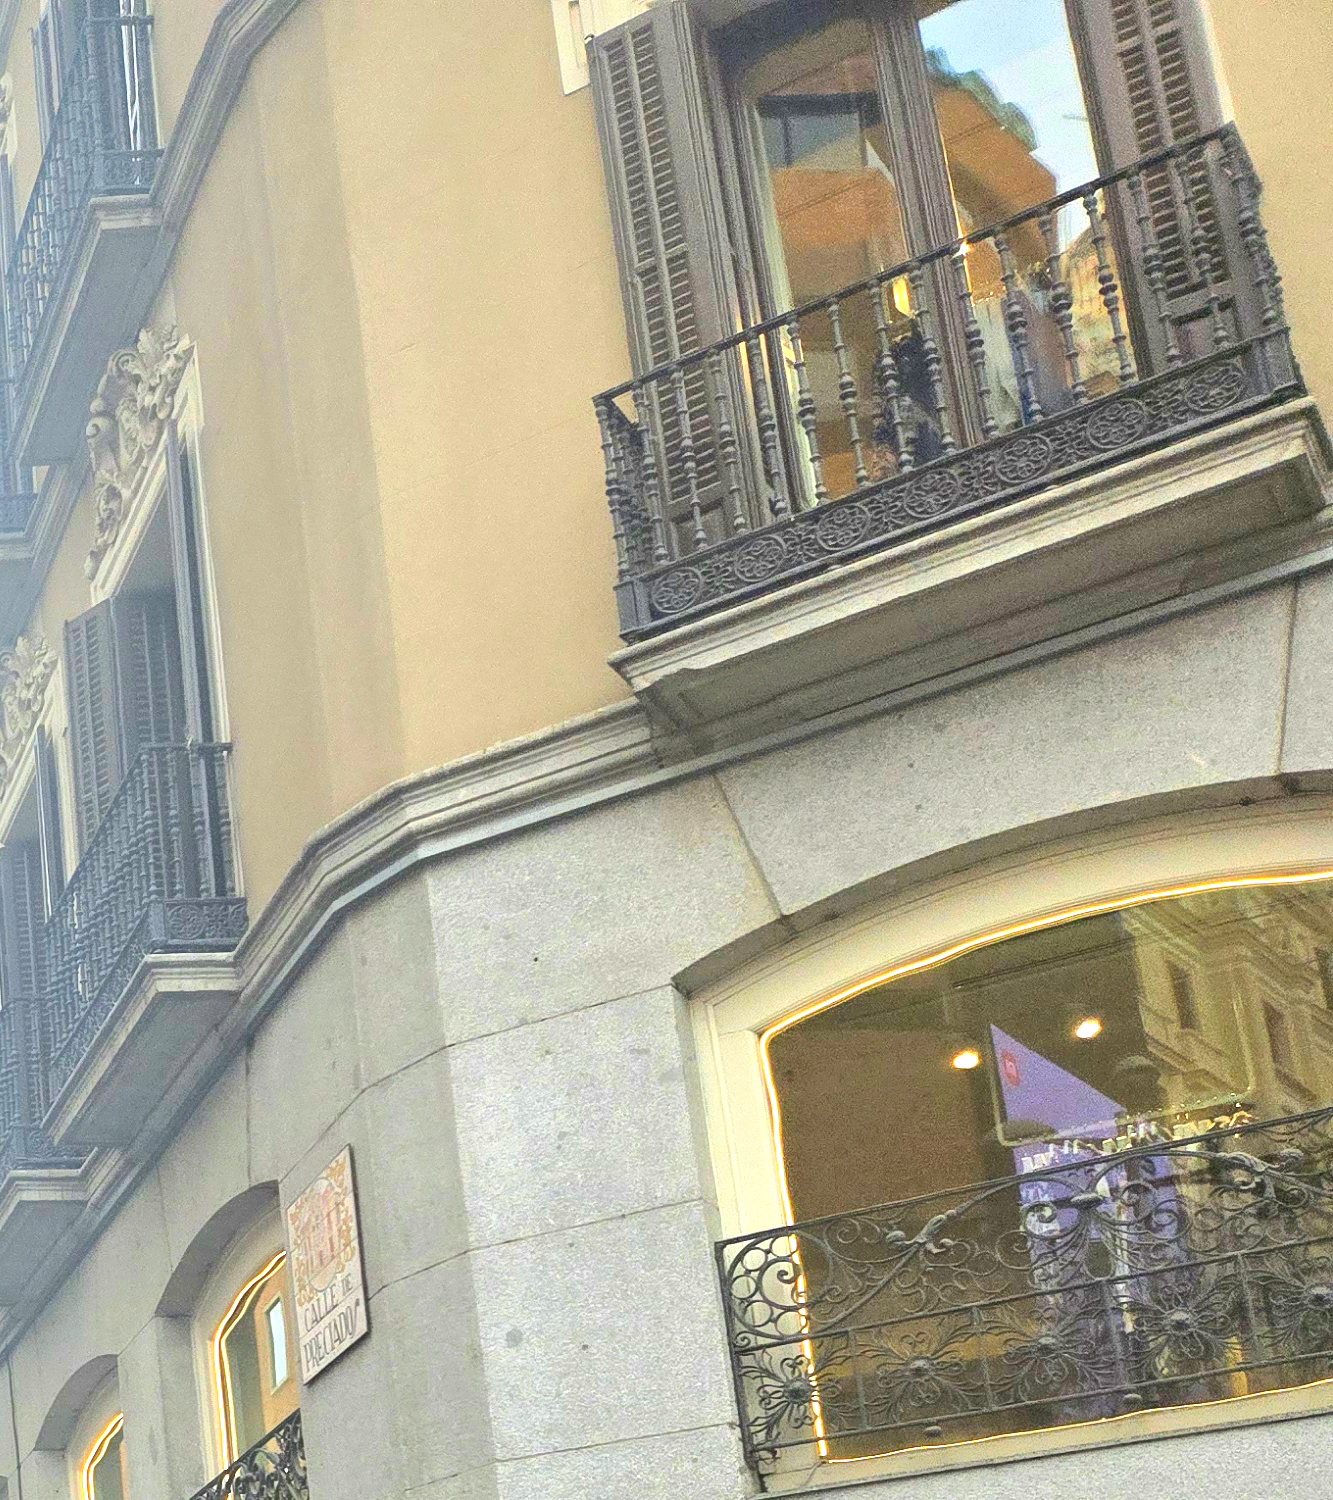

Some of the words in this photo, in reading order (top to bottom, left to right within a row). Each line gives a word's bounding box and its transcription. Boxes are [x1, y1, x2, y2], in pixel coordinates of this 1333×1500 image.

[303, 1298, 360, 1372] PRECIADOS
[304, 1283, 338, 1332] CALLE
[341, 1272, 353, 1297] DE
